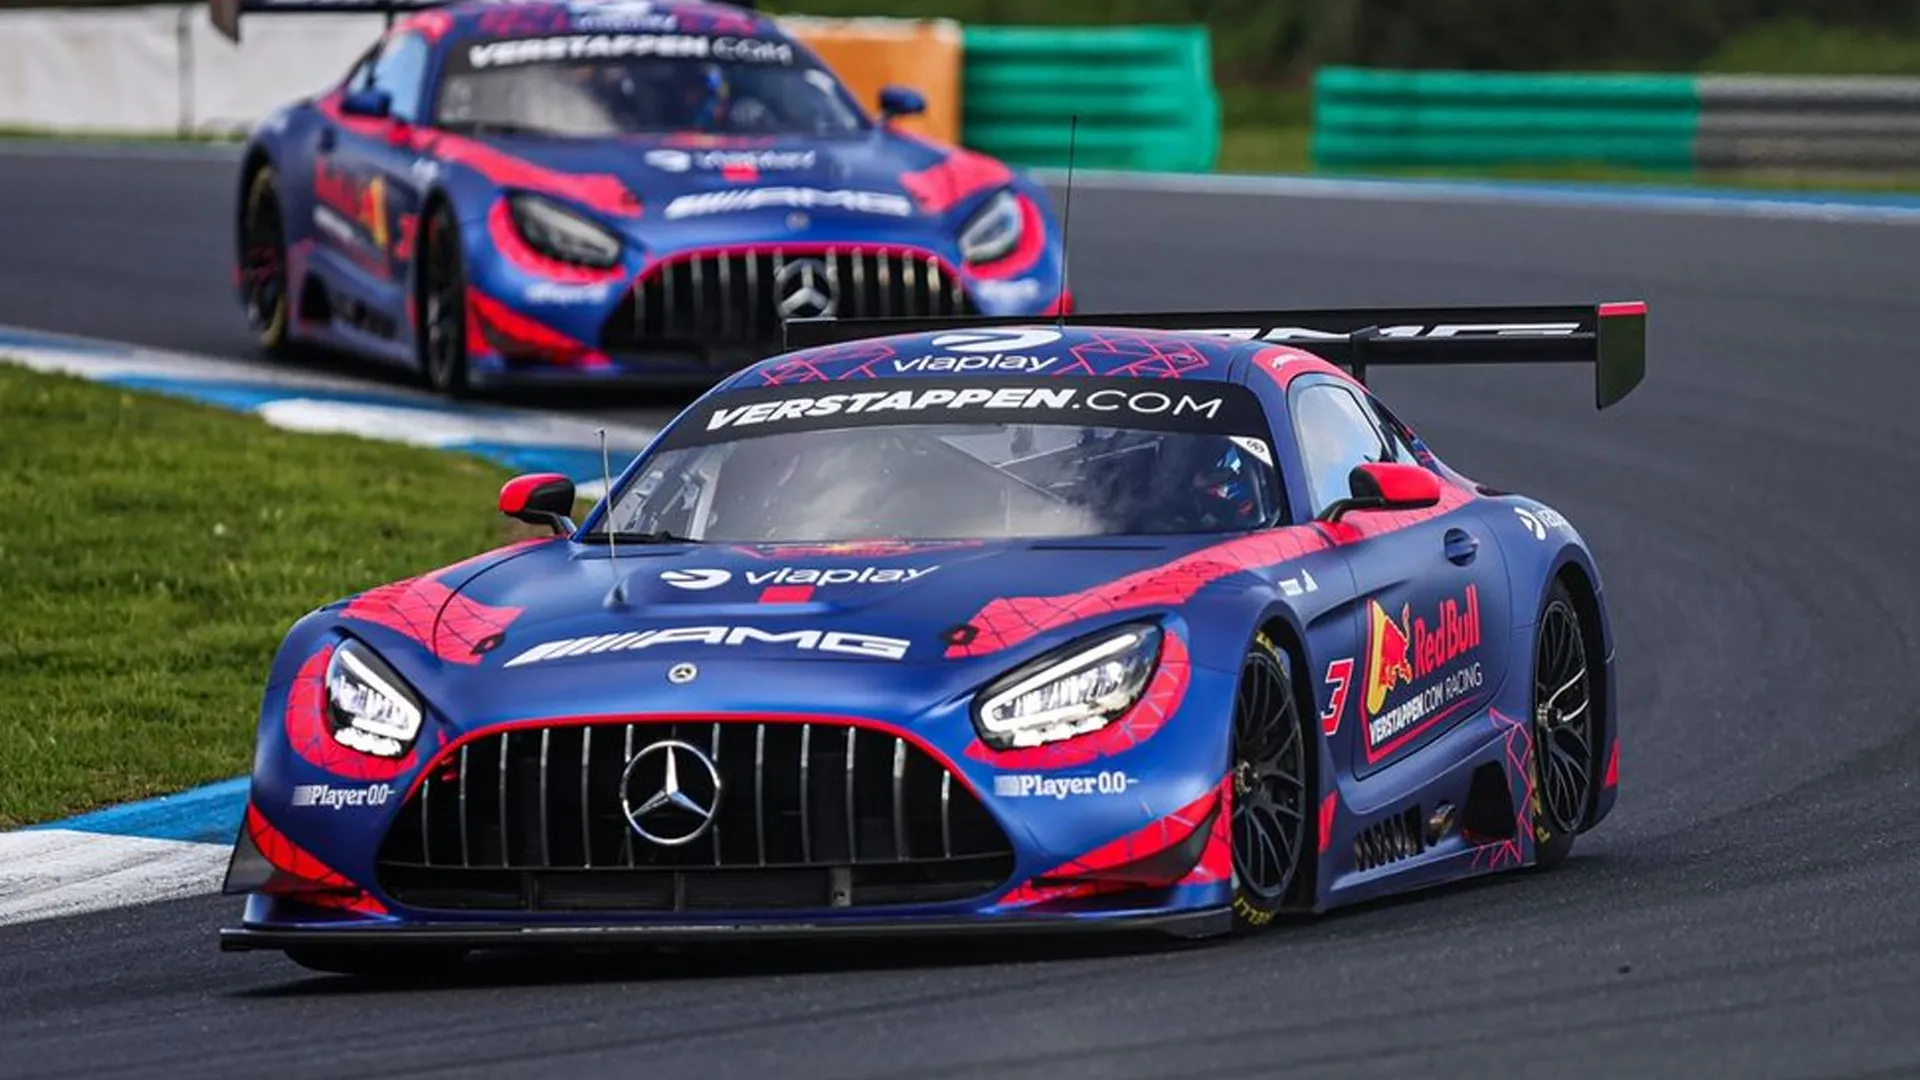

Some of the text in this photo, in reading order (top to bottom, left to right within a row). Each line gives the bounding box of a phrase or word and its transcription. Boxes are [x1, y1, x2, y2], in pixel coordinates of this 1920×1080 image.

[469, 35, 793, 67] VERSTAPPENCOM
[893, 353, 1058, 374] viaplay
[706, 387, 1223, 431] VERSTAPPEN.COM
[743, 565, 940, 587] viaplay
[630, 626, 911, 660] AMG
[1320, 658, 1354, 735] 3
[1444, 661, 1484, 701] RACING
